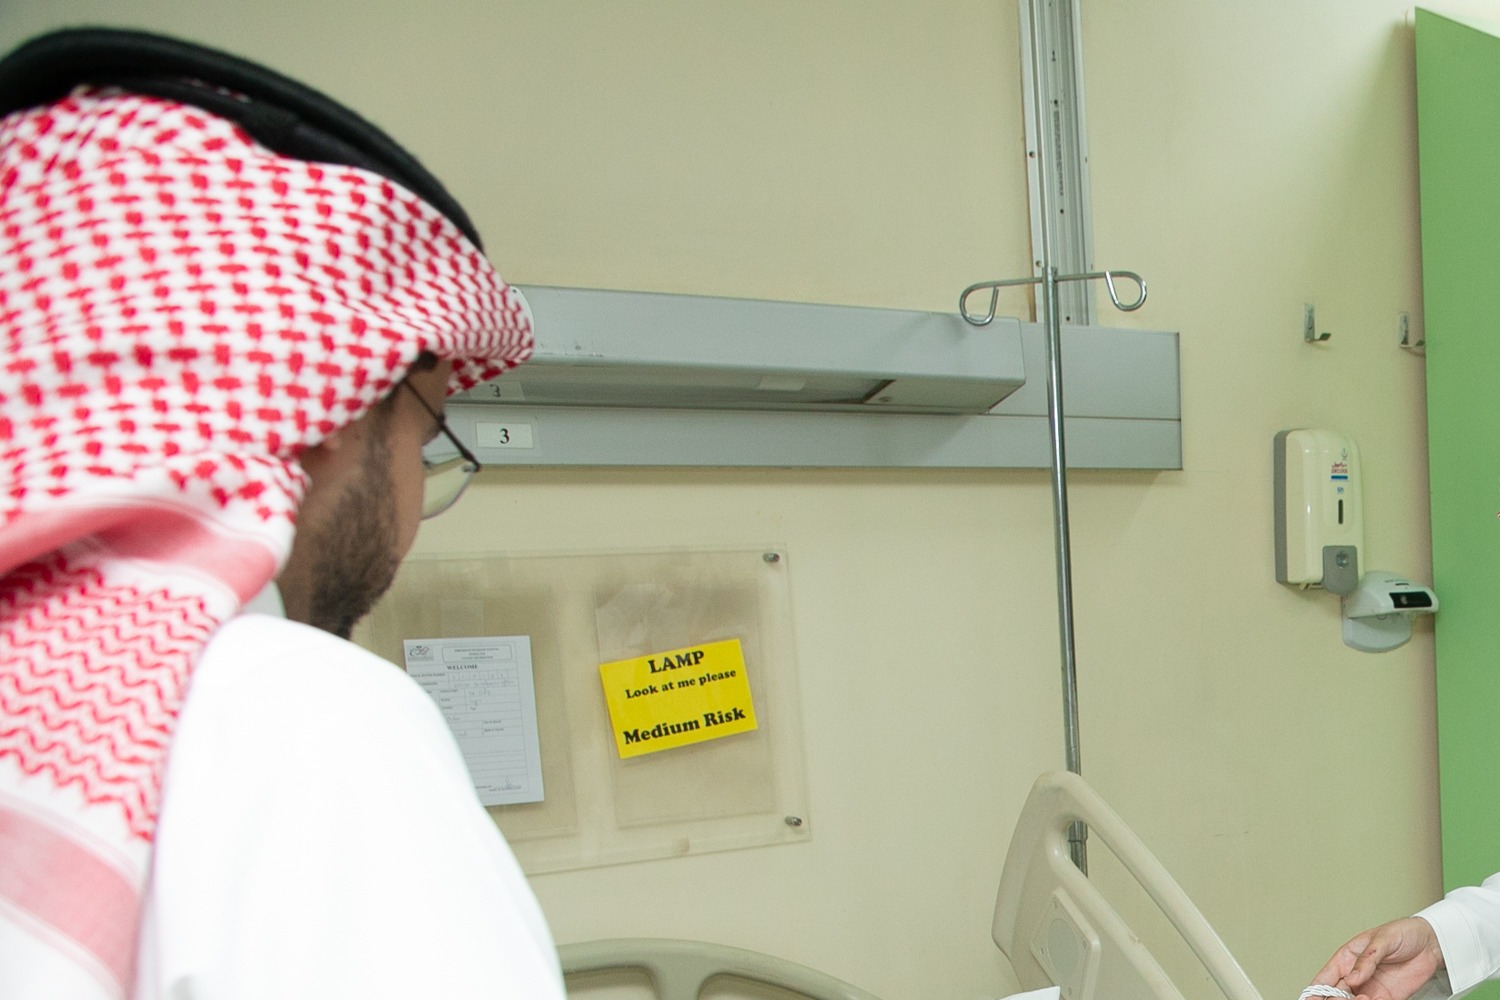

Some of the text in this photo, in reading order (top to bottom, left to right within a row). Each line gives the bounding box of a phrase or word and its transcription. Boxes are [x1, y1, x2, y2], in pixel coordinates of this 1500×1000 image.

[499, 428, 510, 445] 3
[648, 650, 705, 674] LAMP
[625, 669, 737, 699] Look at me please
[623, 707, 746, 745] Medium Risk
